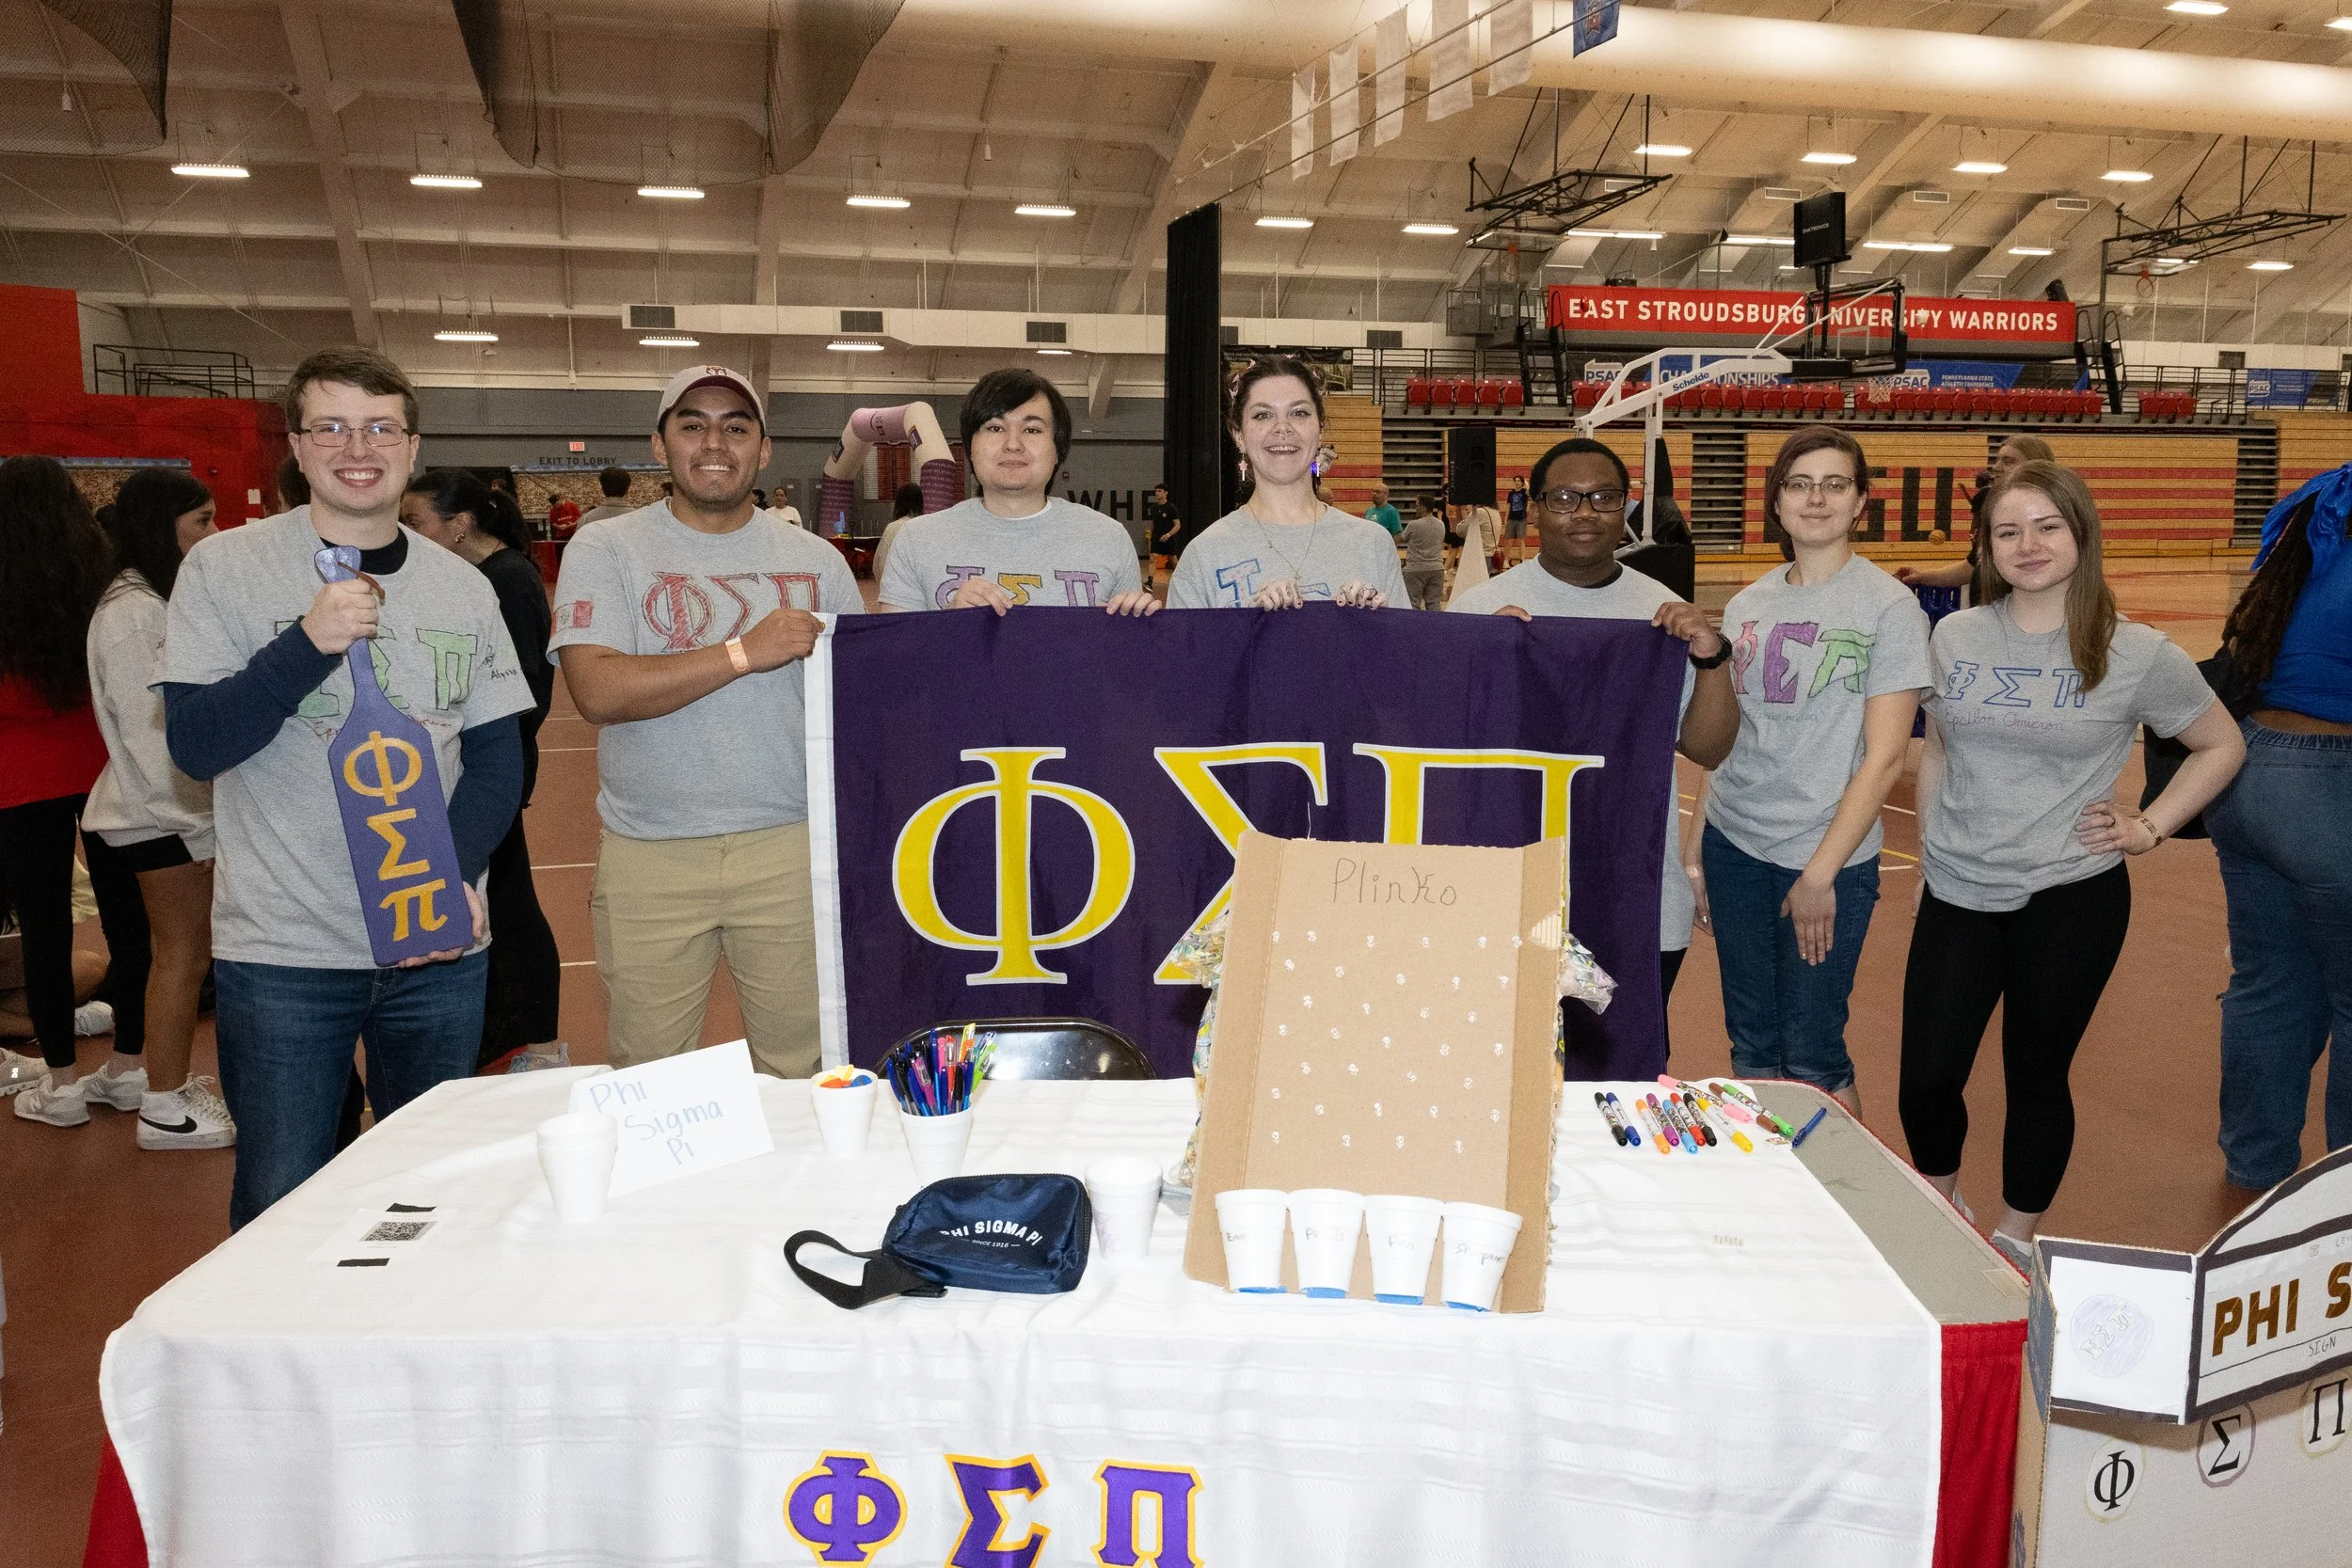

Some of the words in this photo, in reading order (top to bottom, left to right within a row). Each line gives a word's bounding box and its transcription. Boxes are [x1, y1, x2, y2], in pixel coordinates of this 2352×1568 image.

[1569, 298, 1629, 320] EAST
[1638, 300, 1805, 325] STROUDSBURG
[1949, 310, 2058, 330] WARRIORS
[1673, 372, 1709, 391] Schelde
[589, 1081, 647, 1114] Phi
[625, 1101, 723, 1140] Sigma
[666, 1137, 694, 1165] Pi
[975, 1220, 1027, 1238] SIGMA
[1025, 1230, 1043, 1245] PI
[2212, 1278, 2299, 1356] PHI
[2309, 1337, 2337, 1357] SIGN
[2208, 1415, 2241, 1477] Σ
[2309, 1378, 2348, 1444] Π
